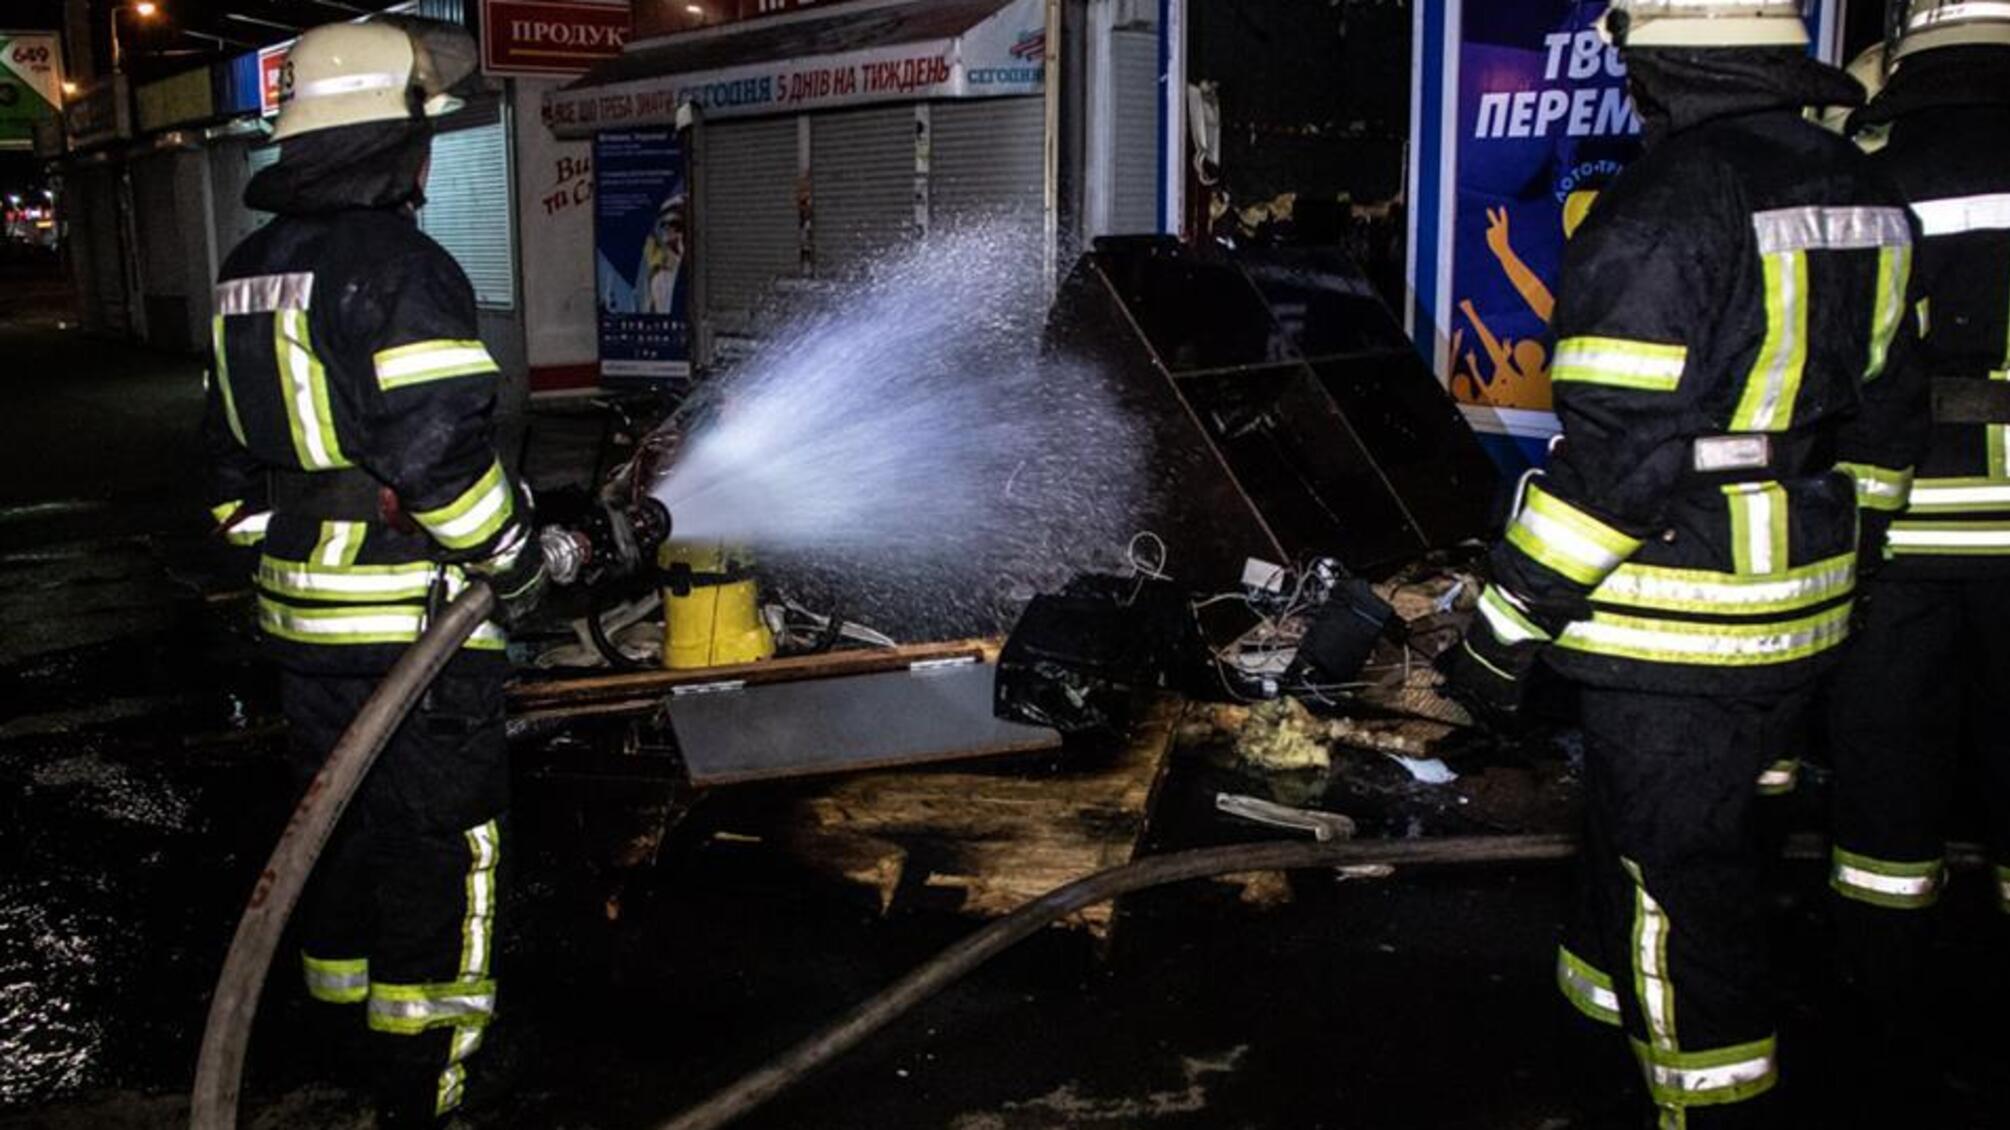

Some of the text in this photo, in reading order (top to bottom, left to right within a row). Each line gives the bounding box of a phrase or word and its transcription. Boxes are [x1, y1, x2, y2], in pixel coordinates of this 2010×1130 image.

[777, 74, 788, 101] 5
[790, 71, 830, 103] ДНІВ
[834, 69, 856, 97] НА
[862, 55, 949, 93] ТИЖДЕНЬ
[1475, 88, 1642, 138] ПЕРЕМ
